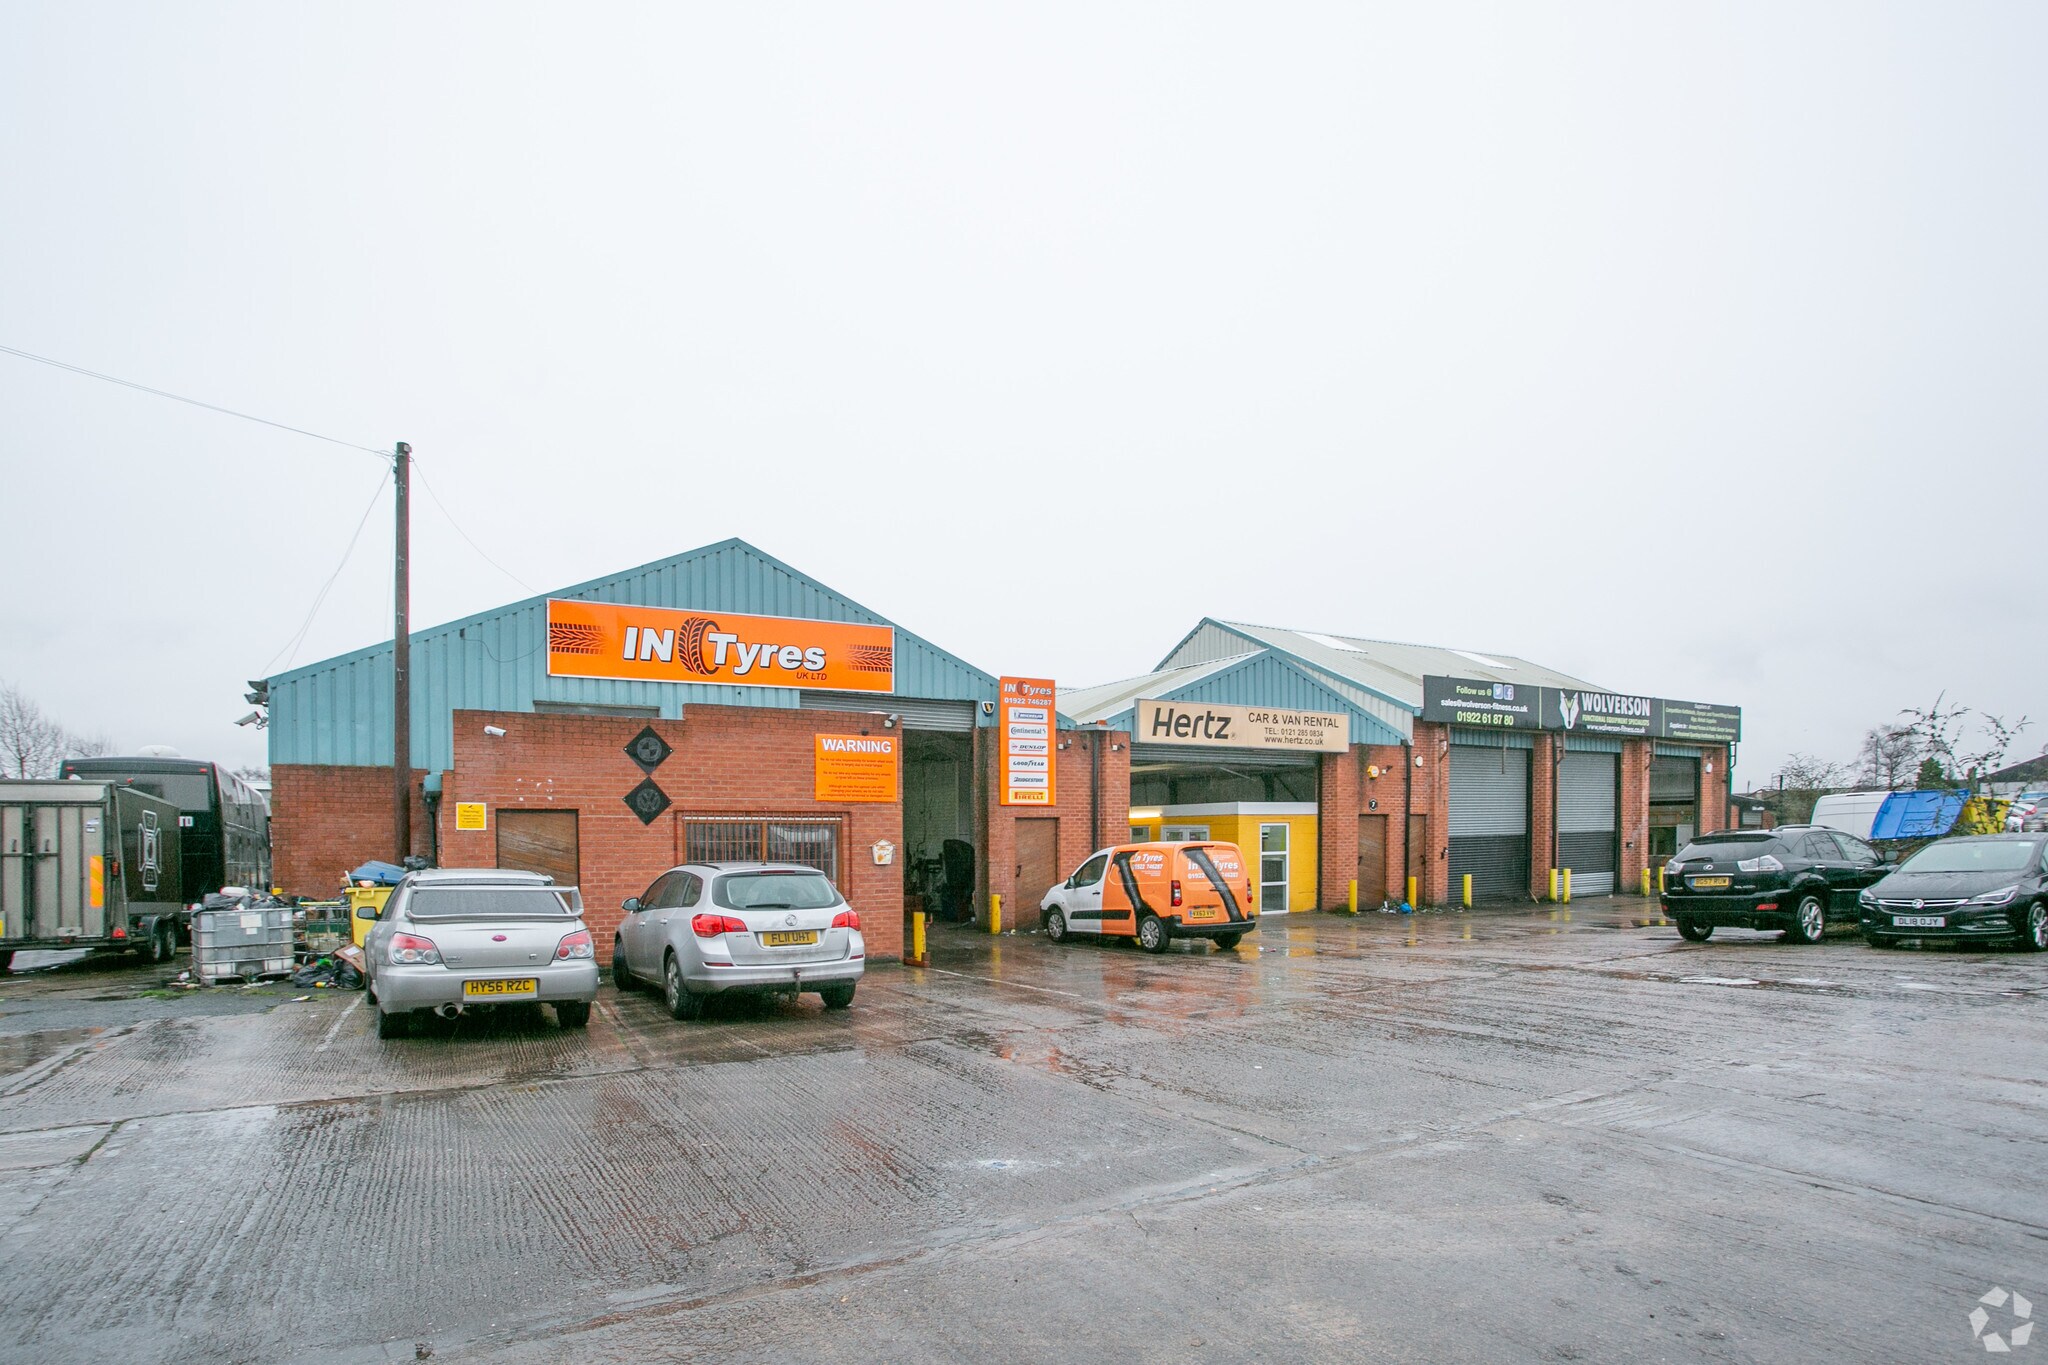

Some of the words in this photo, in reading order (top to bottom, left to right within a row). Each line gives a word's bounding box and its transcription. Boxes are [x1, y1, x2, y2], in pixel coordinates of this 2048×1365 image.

[623, 626, 675, 662] IN
[708, 632, 826, 675] Tyres
[796, 672, 809, 680] UK
[811, 672, 827, 681] LTD
[1004, 683, 1016, 692] IN
[1023, 684, 1052, 696] Tyres
[1456, 686, 1477, 695] Follow
[1582, 692, 1650, 716] WOLVERSON
[1152, 708, 1231, 740] Hertz
[1248, 713, 1270, 724] CAR
[1273, 714, 1279, 724] &
[1282, 715, 1300, 725] VAN
[1304, 716, 1339, 728] RENTAL
[1457, 711, 1481, 722] 01922
[1482, 713, 1491, 723] 61
[1493, 714, 1502, 724] 87
[1504, 715, 1514, 725] 80
[822, 738, 892, 753] WARNING
[1264, 736, 1324, 746] www.hertz.co.uk
[1142, 854, 1163, 863] Tyres
[1213, 860, 1238, 871] Tyres
[772, 933, 790, 943] FL11
[792, 932, 810, 942] UHT
[471, 980, 502, 993] HY56
[507, 980, 530, 992] RZC
